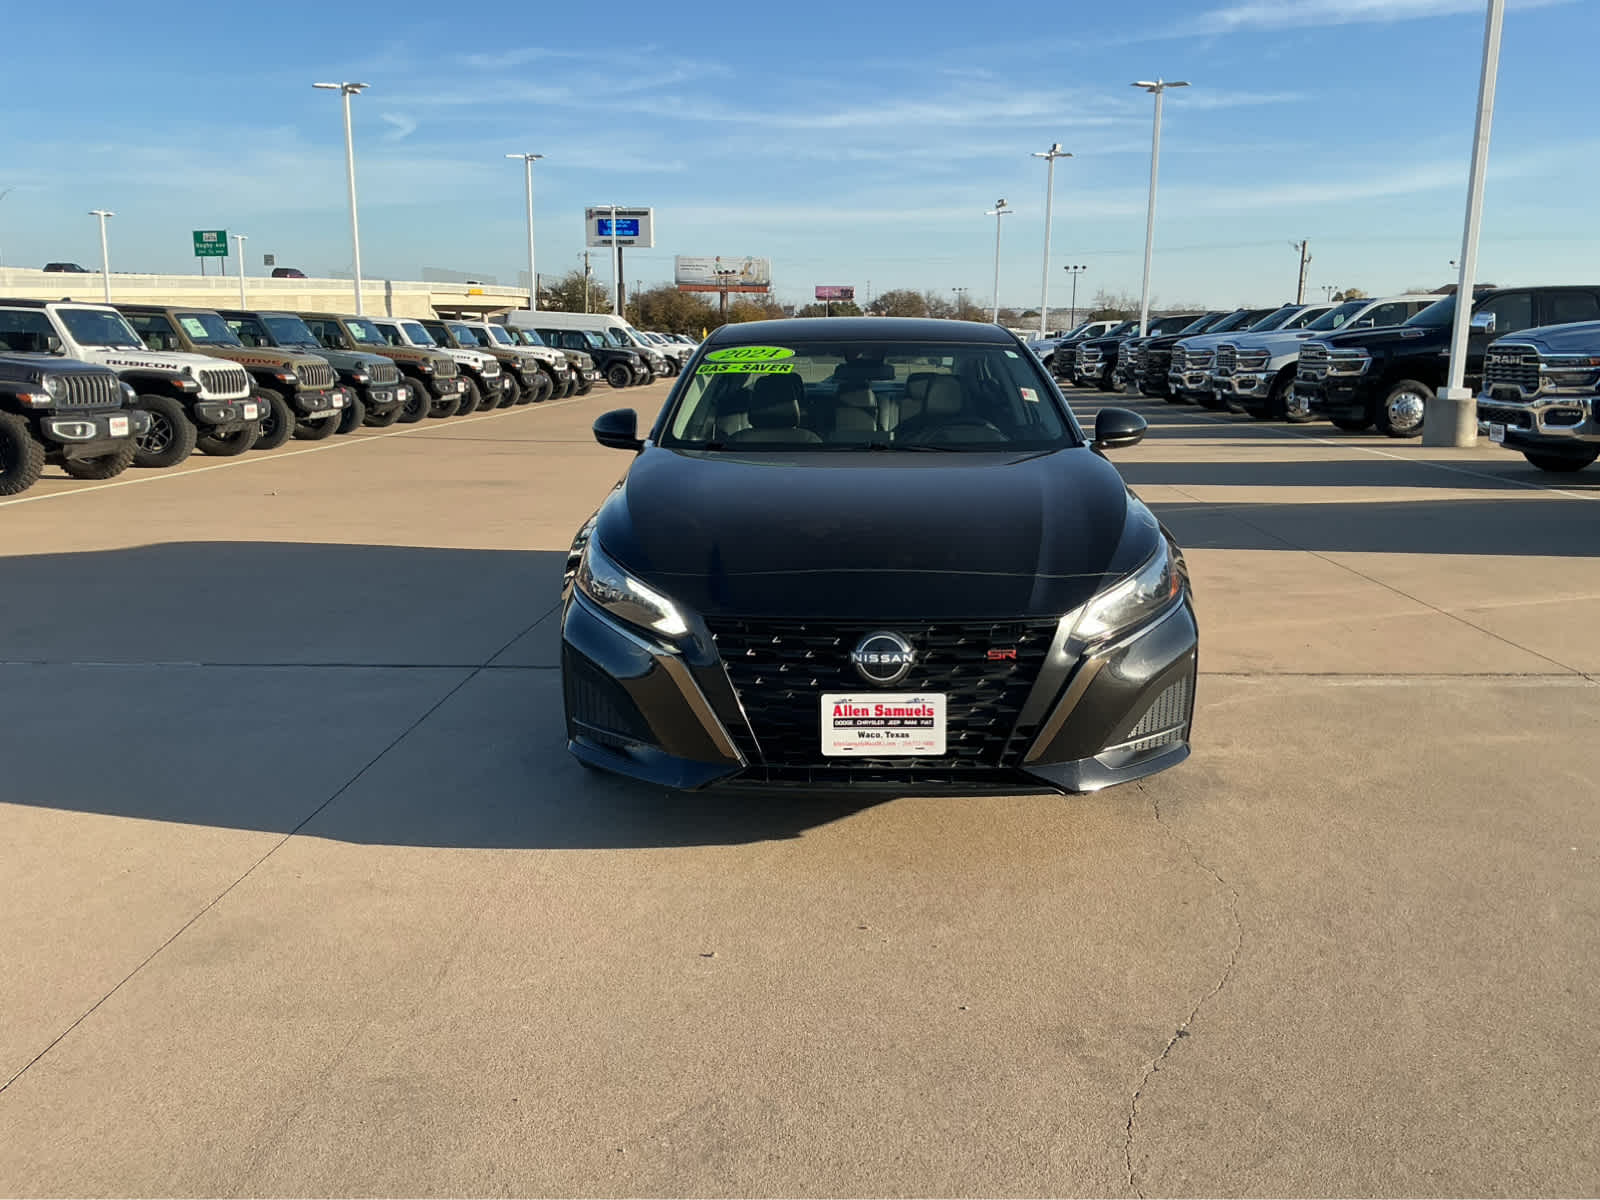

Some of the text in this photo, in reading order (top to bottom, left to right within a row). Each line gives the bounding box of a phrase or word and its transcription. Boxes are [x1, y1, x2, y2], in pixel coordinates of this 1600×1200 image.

[719, 349, 780, 359] 2024
[1492, 354, 1520, 364] RAM
[105, 359, 178, 370] RUBICON
[700, 364, 729, 373] GAS
[740, 364, 790, 372] SAVER
[851, 652, 914, 663] NISSAN
[987, 649, 1017, 660] SR
[833, 704, 934, 717] Allen Samuels
[857, 731, 910, 739] Waco, Texas
